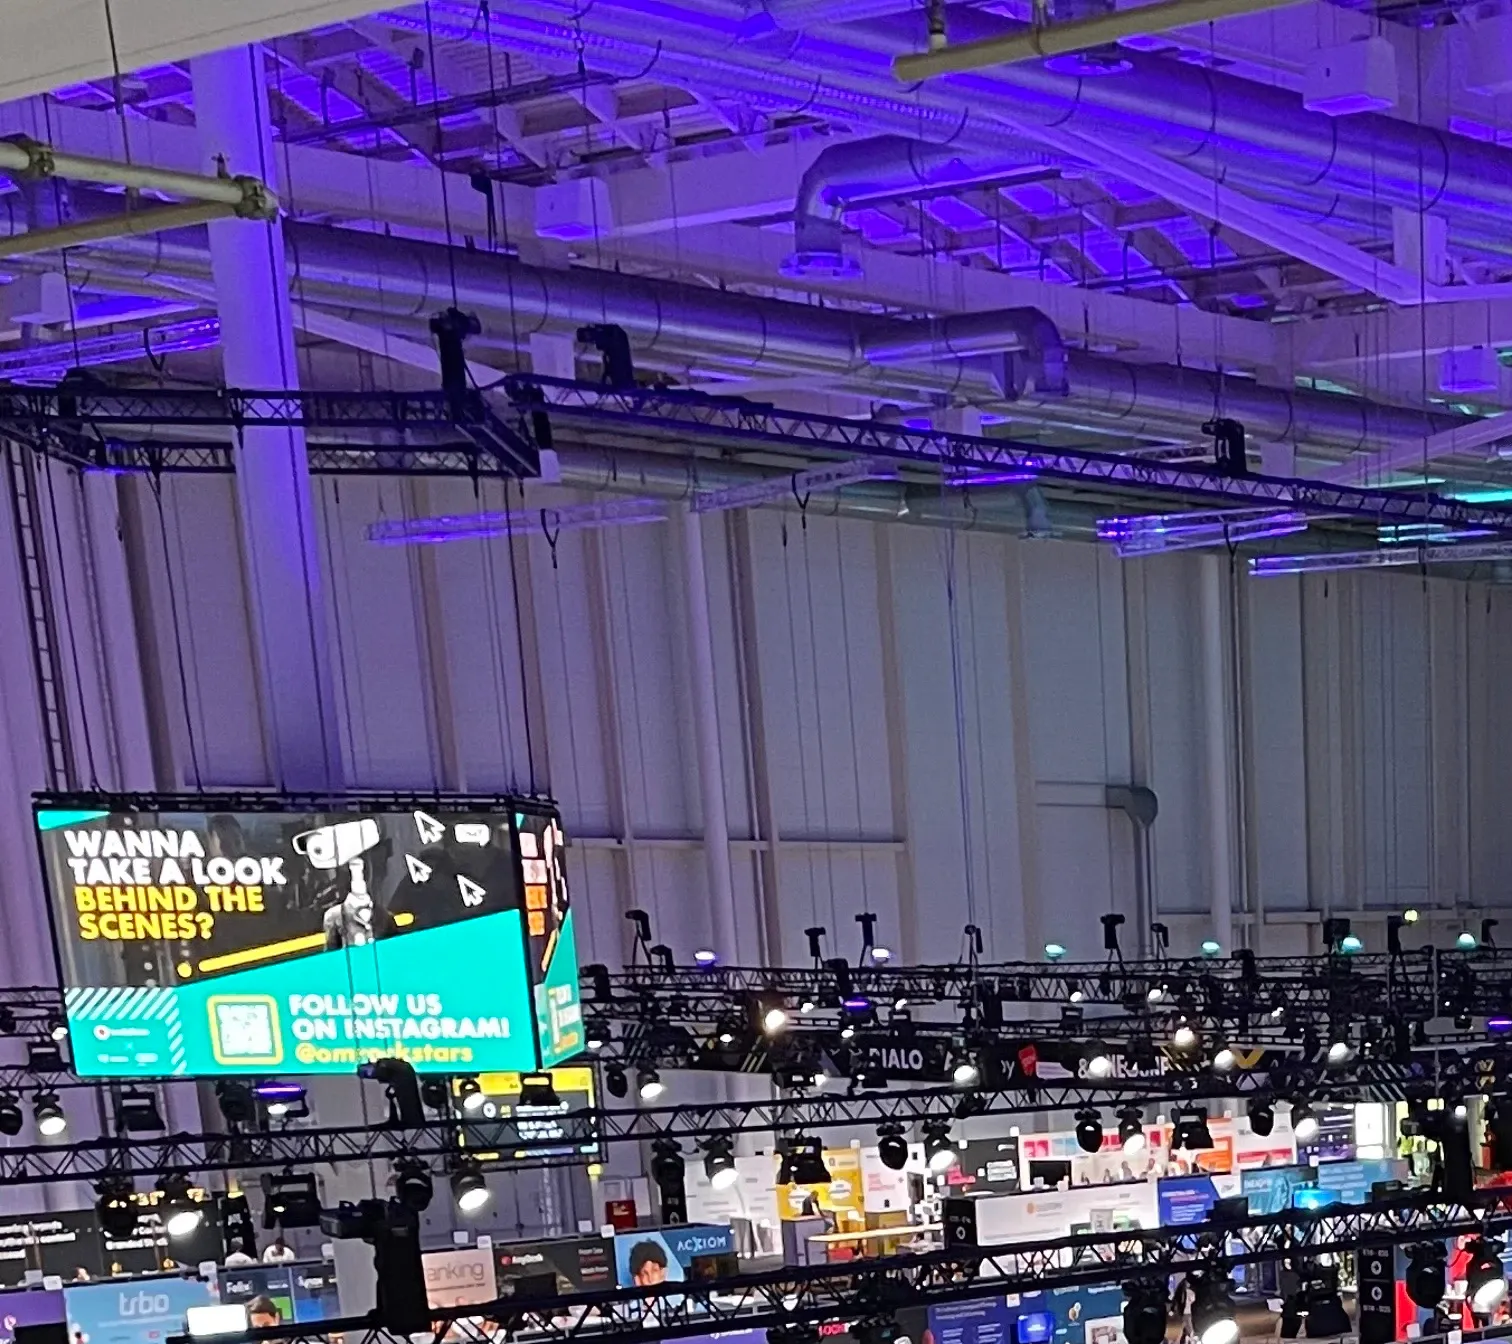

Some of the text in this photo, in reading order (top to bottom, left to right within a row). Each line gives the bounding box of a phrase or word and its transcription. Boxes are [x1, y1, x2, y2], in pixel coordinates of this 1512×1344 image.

[64, 829, 205, 858] WANNA
[67, 856, 287, 885] TAKE A LOOK
[74, 885, 265, 912] BEHIND THE
[79, 912, 215, 940] SCENES?
[289, 993, 442, 1016] FOLLOW US
[292, 1017, 511, 1041] ON INSTAGRAM!
[676, 1235, 727, 1253] ACXIOM
[119, 1291, 170, 1316] trbo
